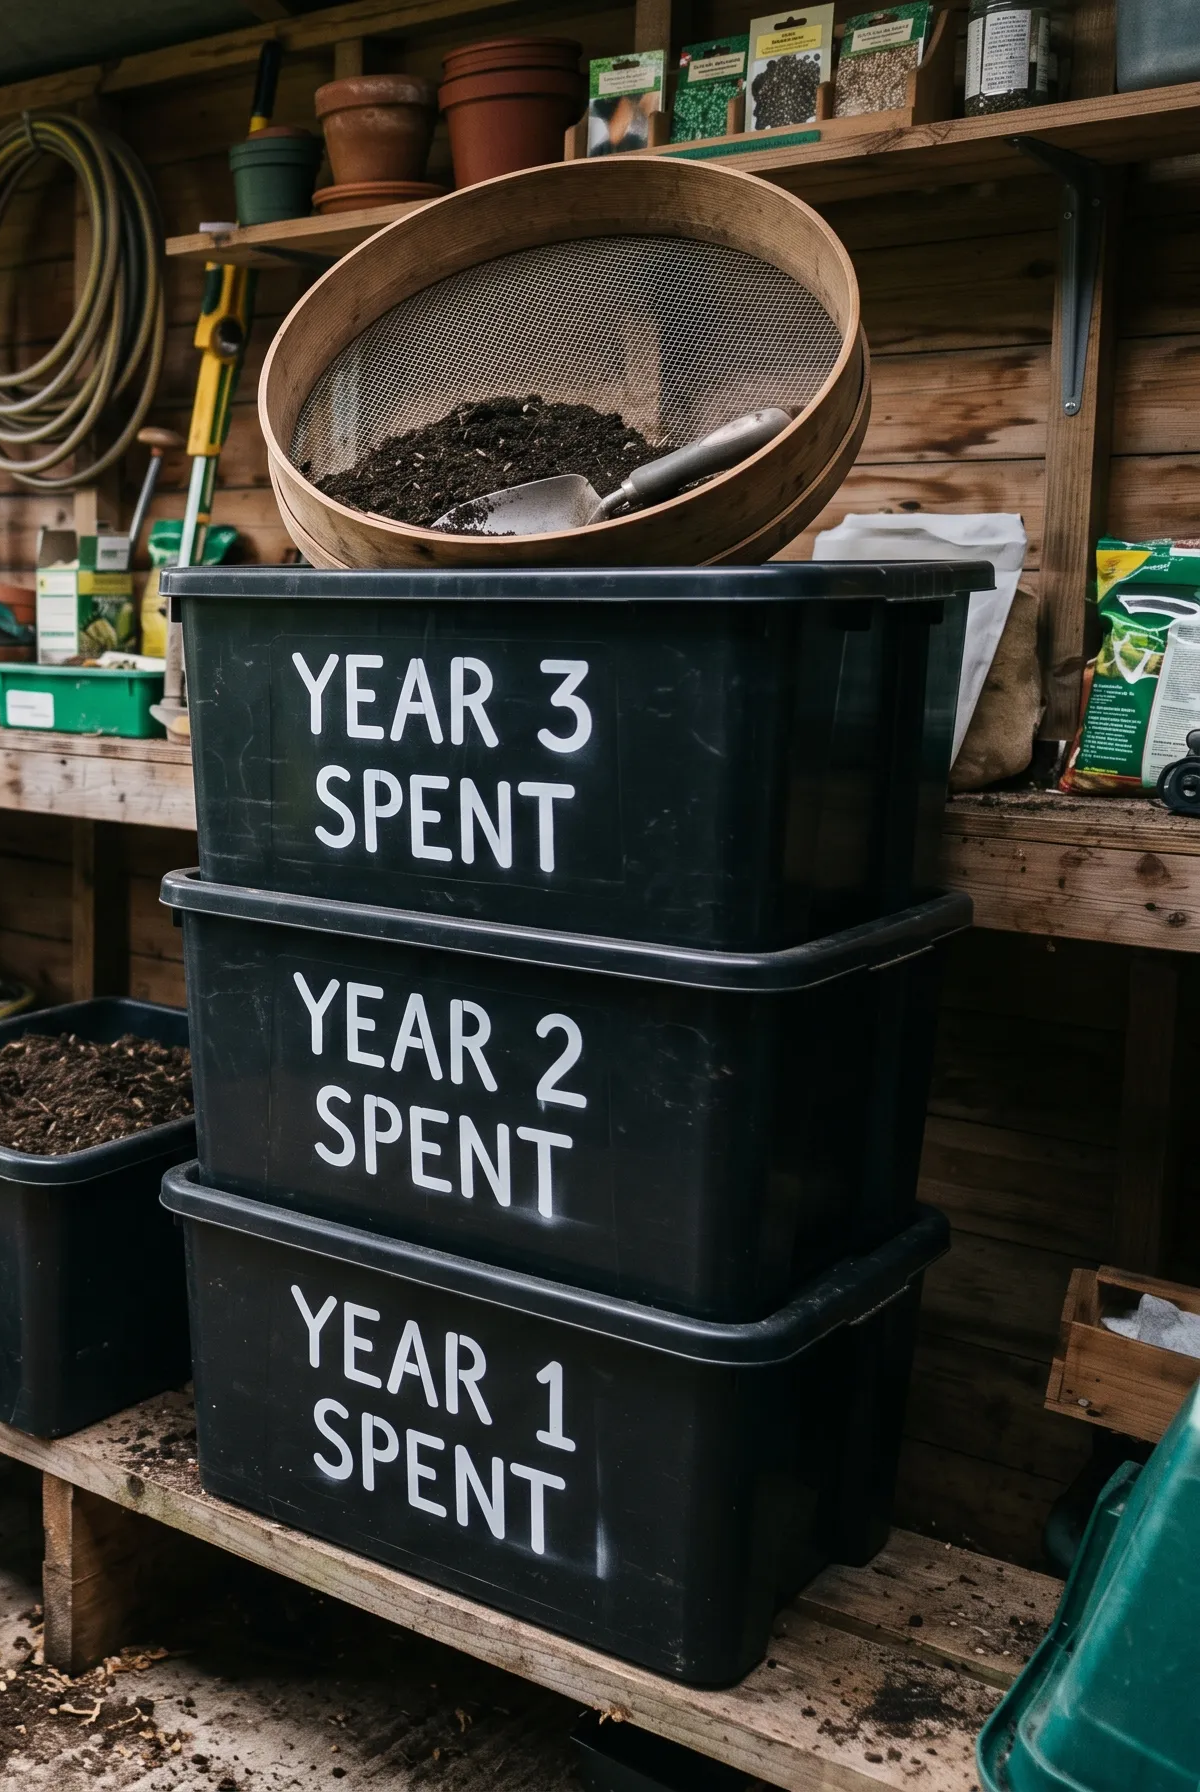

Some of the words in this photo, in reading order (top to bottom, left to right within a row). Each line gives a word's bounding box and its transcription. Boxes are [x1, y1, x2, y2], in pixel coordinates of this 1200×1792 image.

[292, 652, 499, 748] YEAR
[537, 659, 592, 753] 3
[315, 764, 575, 873] SPENT
[293, 971, 498, 1092] YEAR
[536, 1013, 587, 1109] 2
[314, 1084, 573, 1219] SPENT
[291, 1284, 493, 1425] YEAR
[536, 1360, 576, 1451] 1
[313, 1398, 566, 1555] SPENT
